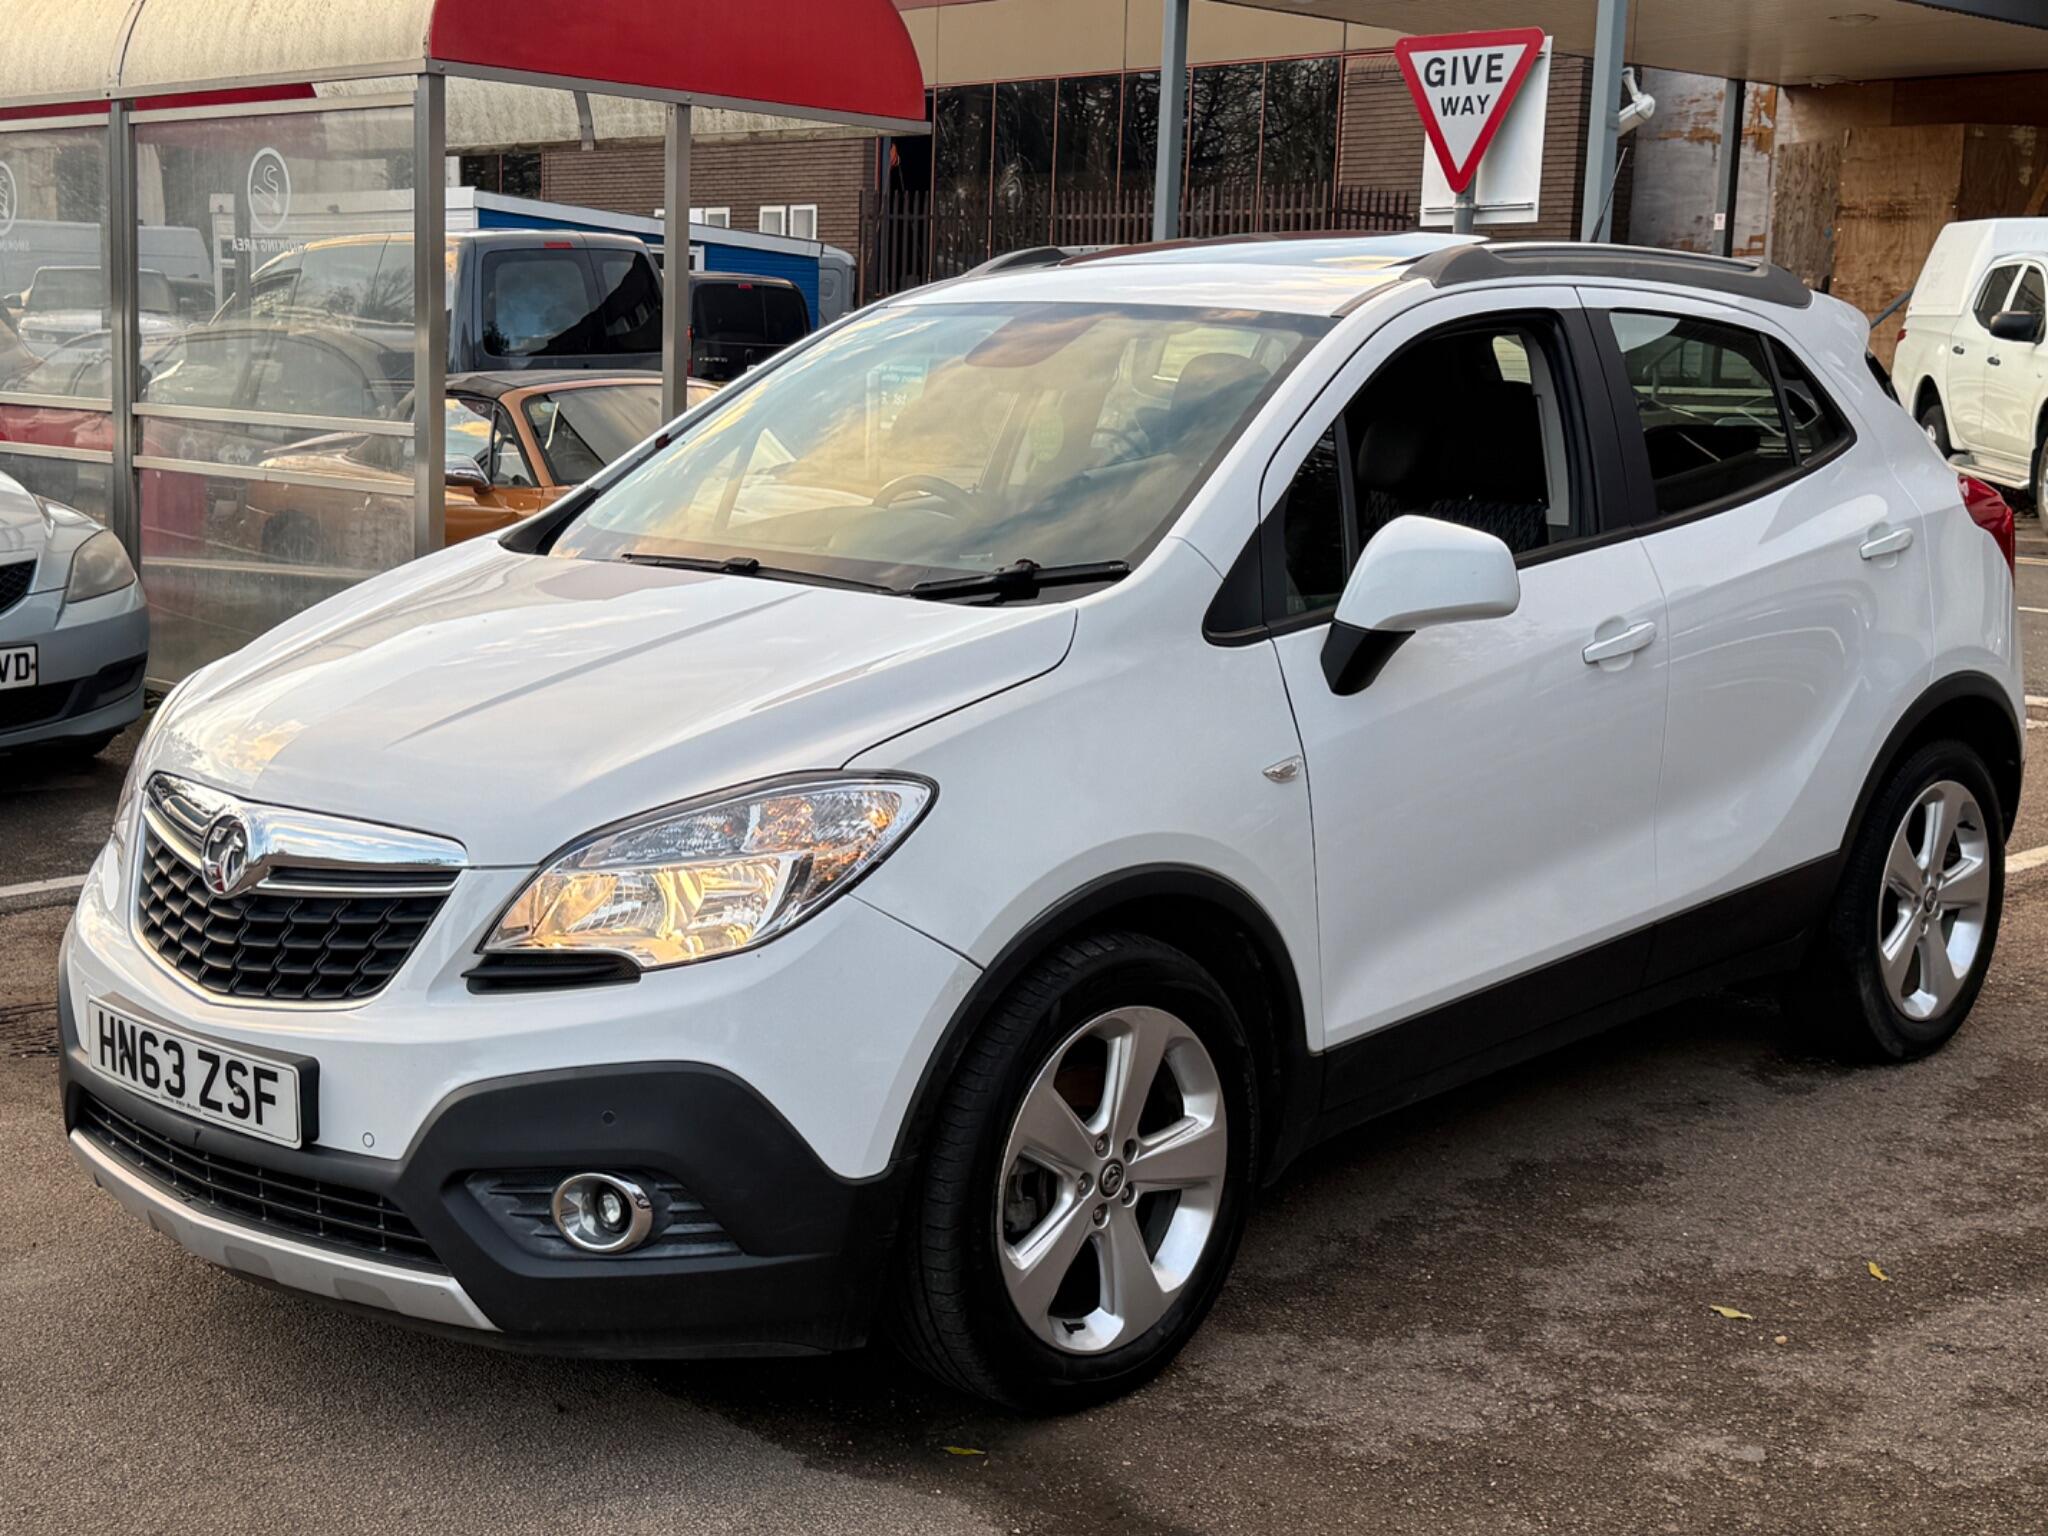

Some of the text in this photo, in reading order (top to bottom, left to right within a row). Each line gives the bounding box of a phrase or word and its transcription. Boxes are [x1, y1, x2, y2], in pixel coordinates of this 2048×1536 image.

[1424, 53, 1504, 88] GIVE
[1441, 94, 1490, 117] WAY
[99, 1010, 279, 1126] HN63 ZSF
